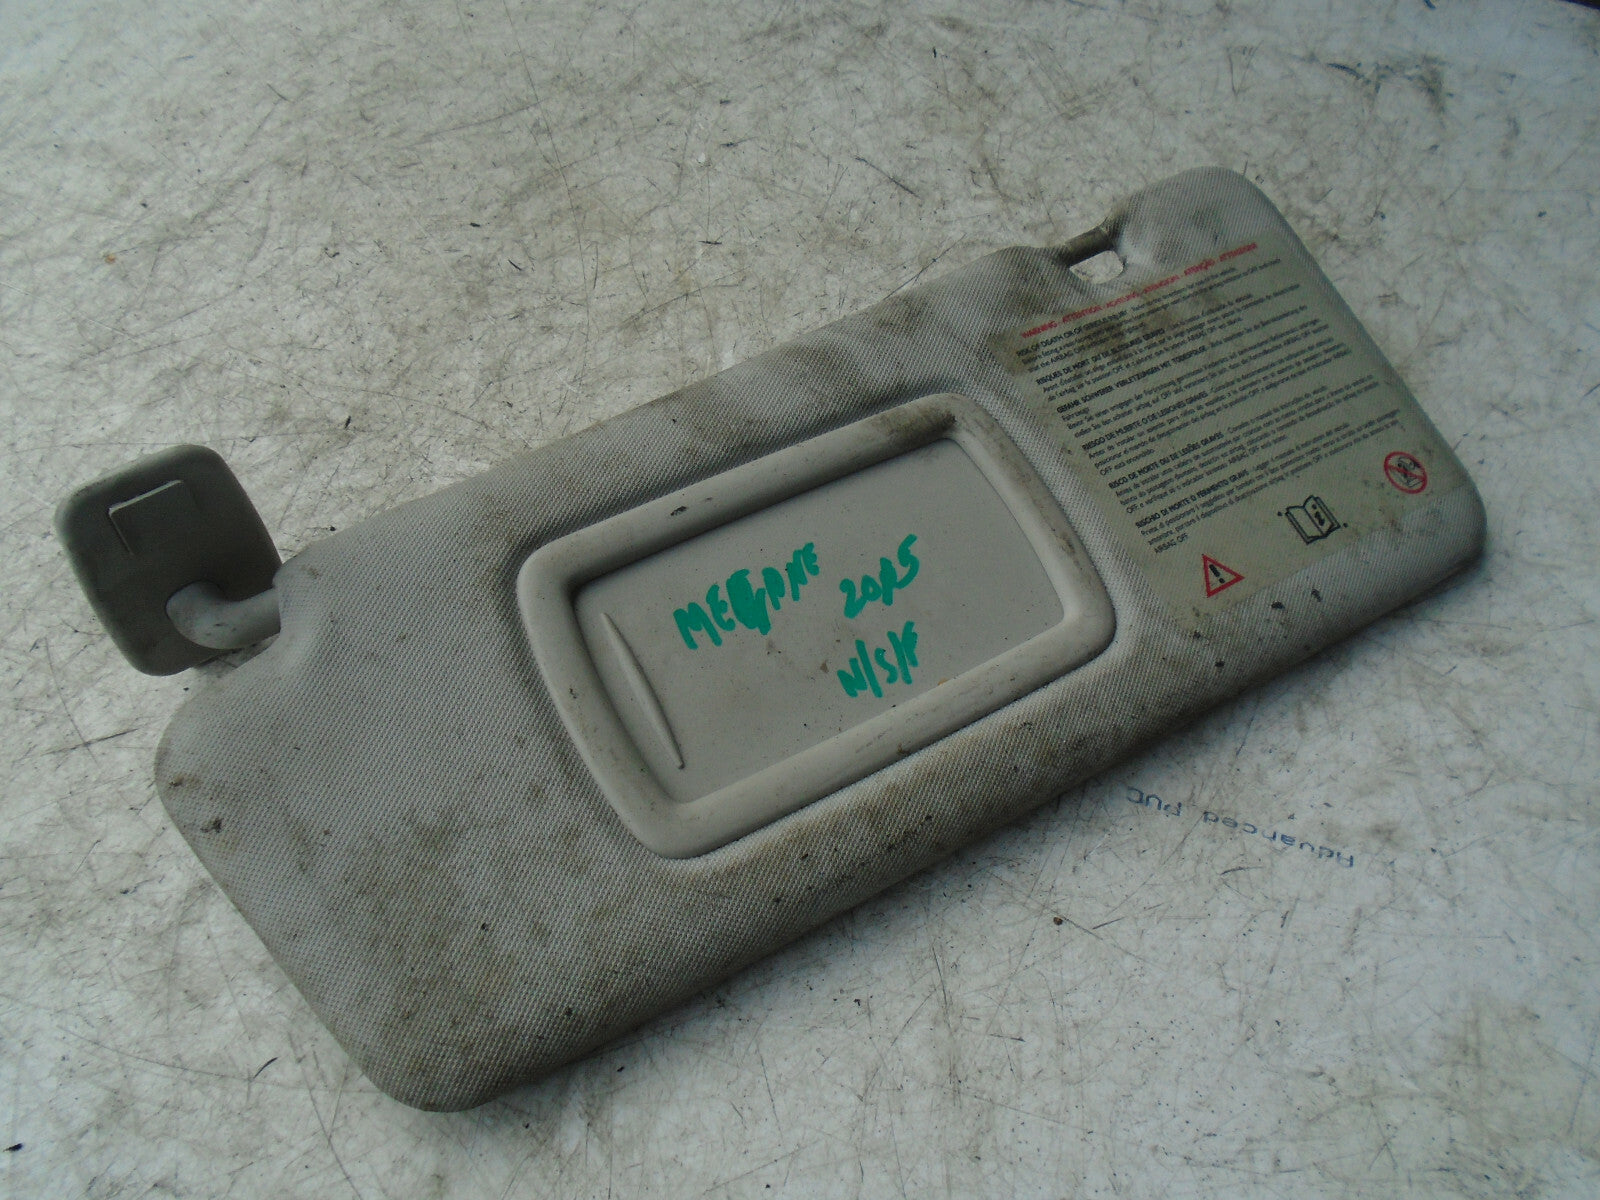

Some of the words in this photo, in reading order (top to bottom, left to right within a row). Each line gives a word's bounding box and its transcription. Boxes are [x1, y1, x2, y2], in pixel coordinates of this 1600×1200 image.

[1019, 320, 1058, 339] WARNING
[1059, 303, 1103, 324] ATTENTION
[1039, 334, 1064, 348] DEATH
[1034, 369, 1063, 385] RISQUES
[1061, 365, 1073, 374] DE
[1070, 358, 1091, 370] MORT
[1054, 398, 1082, 414] GEFAHR
[1079, 384, 1115, 404] SCHWERER
[1113, 364, 1162, 389] VERLETZUNGEN
[1159, 360, 1172, 370] MIT
[1171, 345, 1209, 365] TODESFOLGE
[1080, 435, 1106, 451] RIESGO
[1104, 431, 1117, 441] DE
[1114, 419, 1142, 436] MUERTE
[1139, 417, 1149, 425] O
[1146, 412, 1159, 422] DE
[1184, 390, 1209, 405] GRAVES
[1107, 475, 1129, 489] RISCO
[1126, 471, 1138, 480] DE
[1136, 461, 1160, 476] MORTE
[1158, 456, 1171, 466] OU
[1168, 452, 1180, 461] DE
[1176, 440, 1202, 457] LESÕES
[1199, 431, 1225, 447] GRAVES
[1134, 511, 1161, 528] RISCHIO
[1159, 507, 1170, 516] DI
[1167, 497, 1191, 513] MORTE
[1189, 494, 1198, 502] O
[1195, 478, 1231, 499] FERIMENTO
